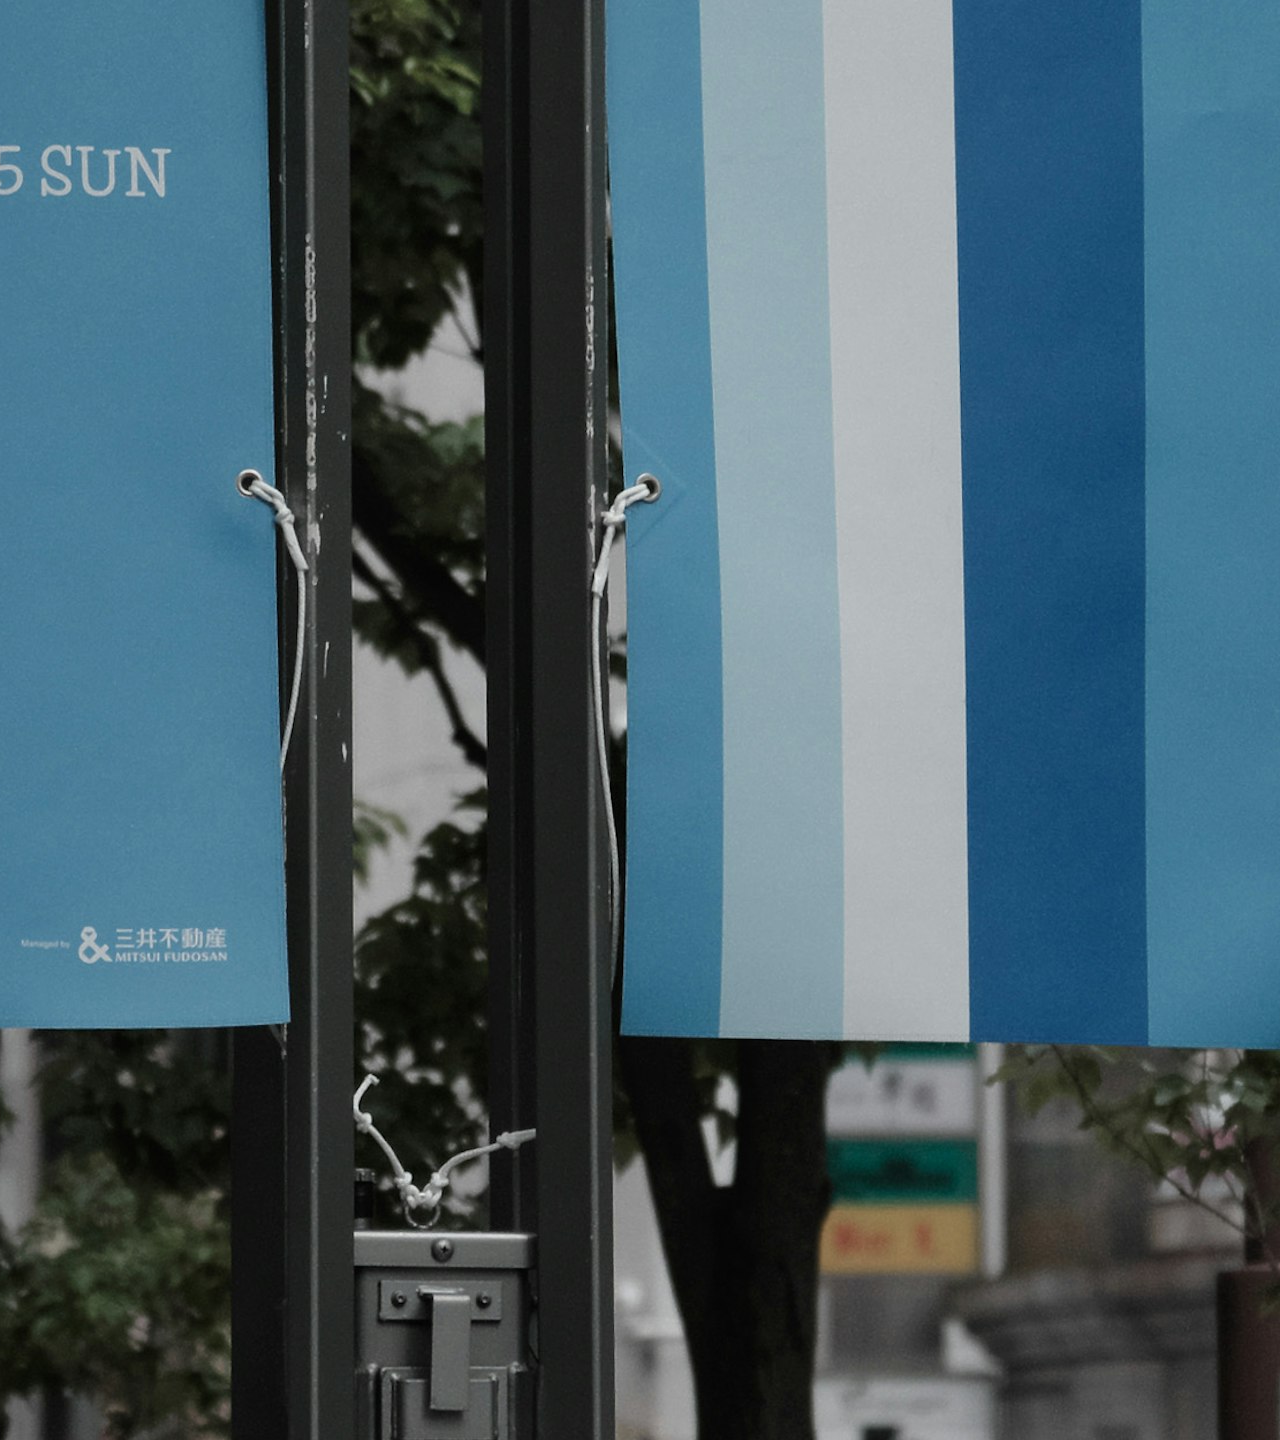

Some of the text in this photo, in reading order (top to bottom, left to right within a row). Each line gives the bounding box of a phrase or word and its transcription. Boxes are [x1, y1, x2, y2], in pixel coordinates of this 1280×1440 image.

[40, 144, 172, 198] SUN
[115, 927, 228, 949] 三井不動産
[115, 951, 228, 963] MITSUI FUDOSAN
